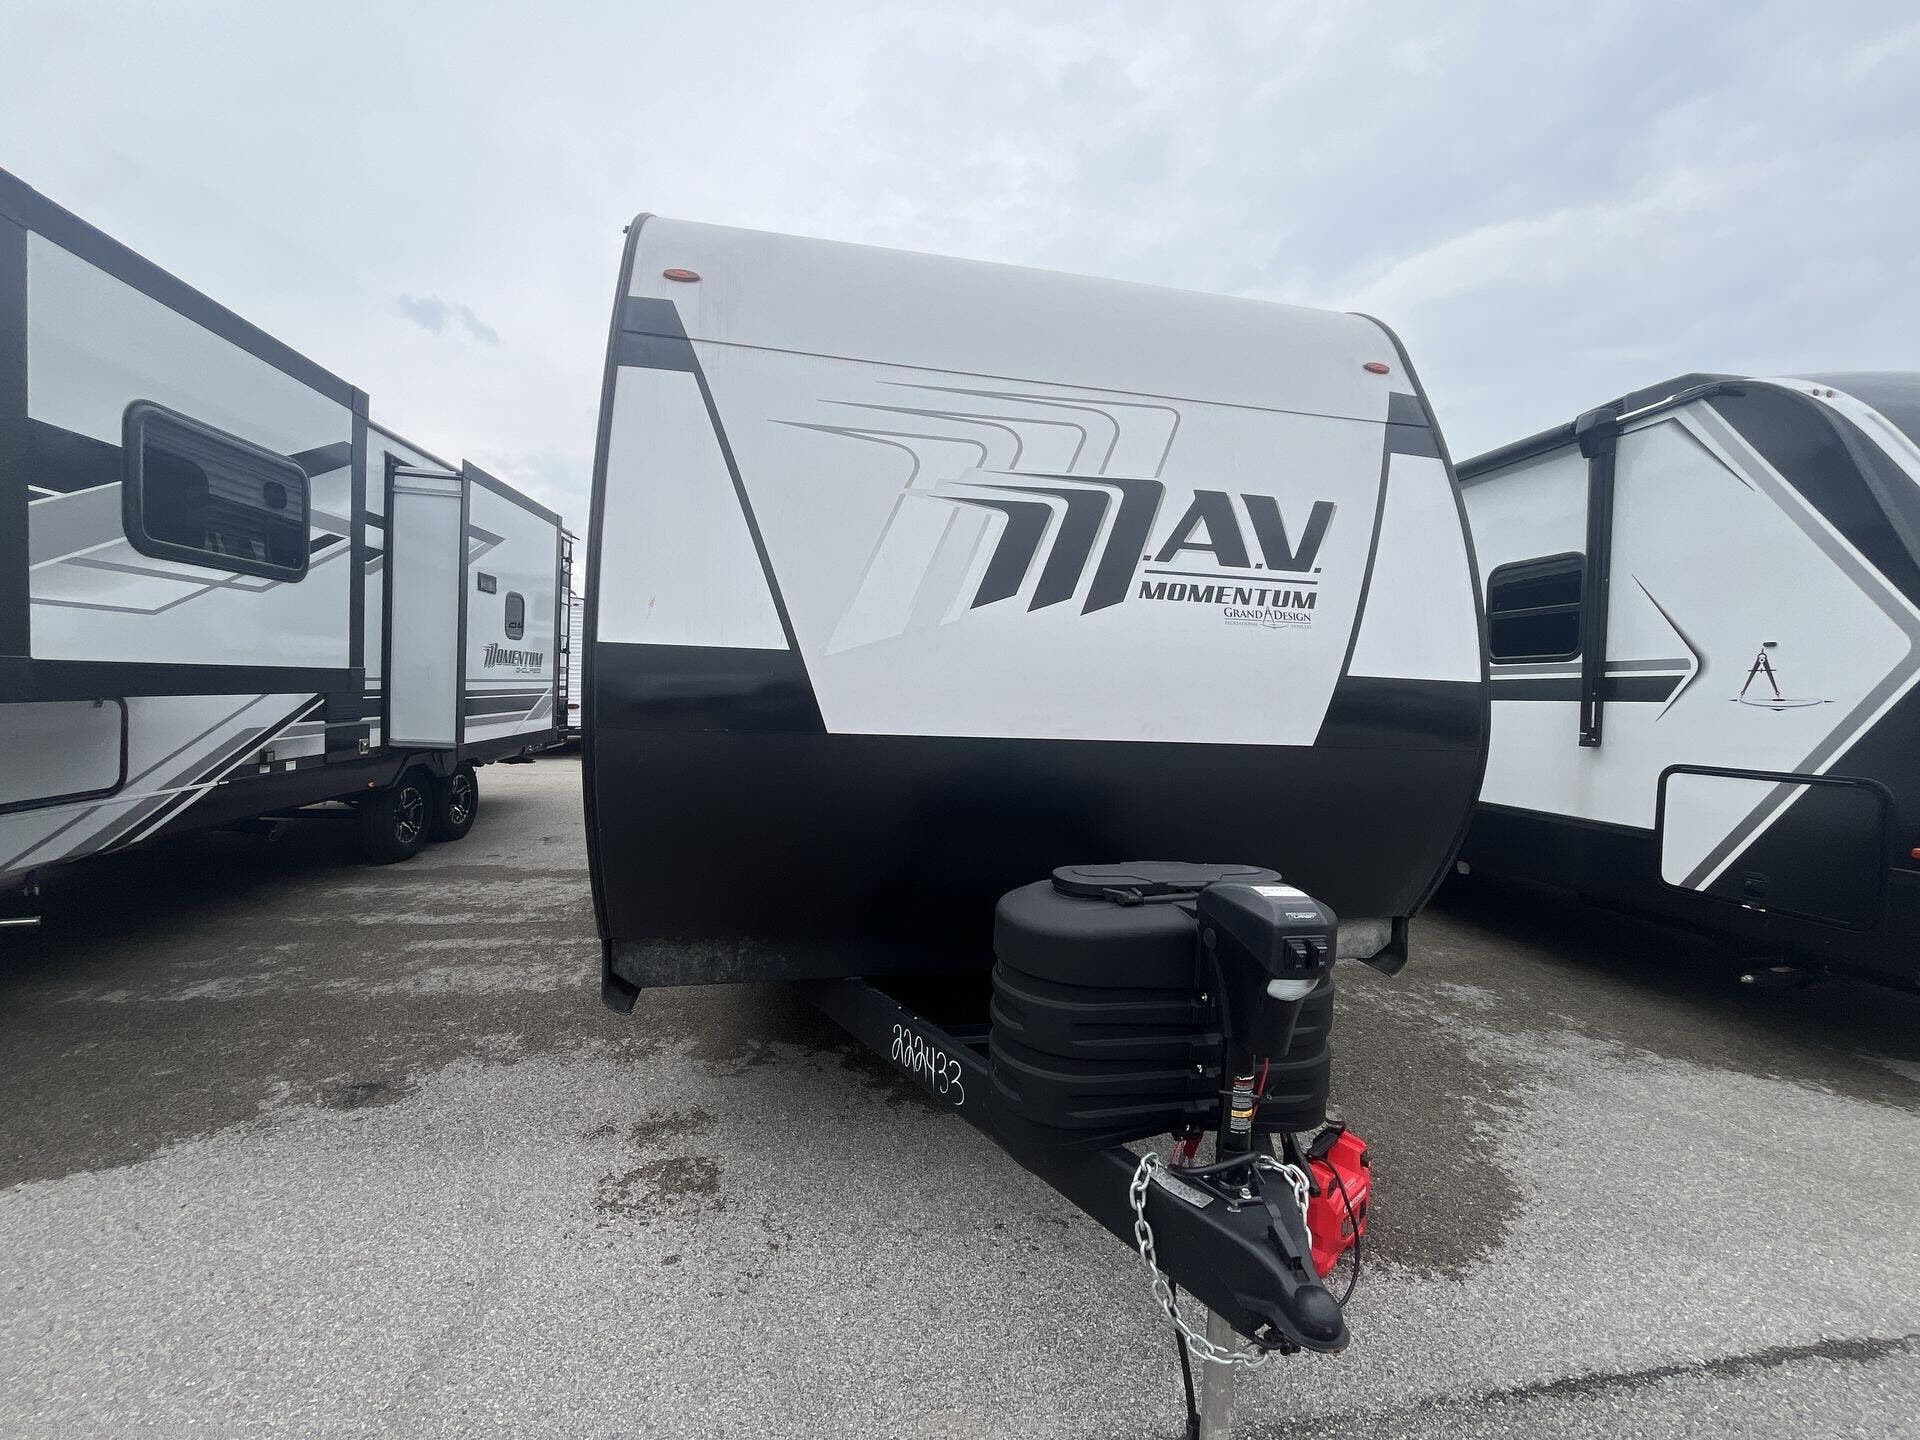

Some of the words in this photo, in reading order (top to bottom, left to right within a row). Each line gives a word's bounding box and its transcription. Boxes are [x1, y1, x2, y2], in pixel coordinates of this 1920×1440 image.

[1138, 581, 1317, 609] MOMENTUM
[482, 643, 543, 668] MOMENTUM
[892, 1024, 964, 1106] 222433
